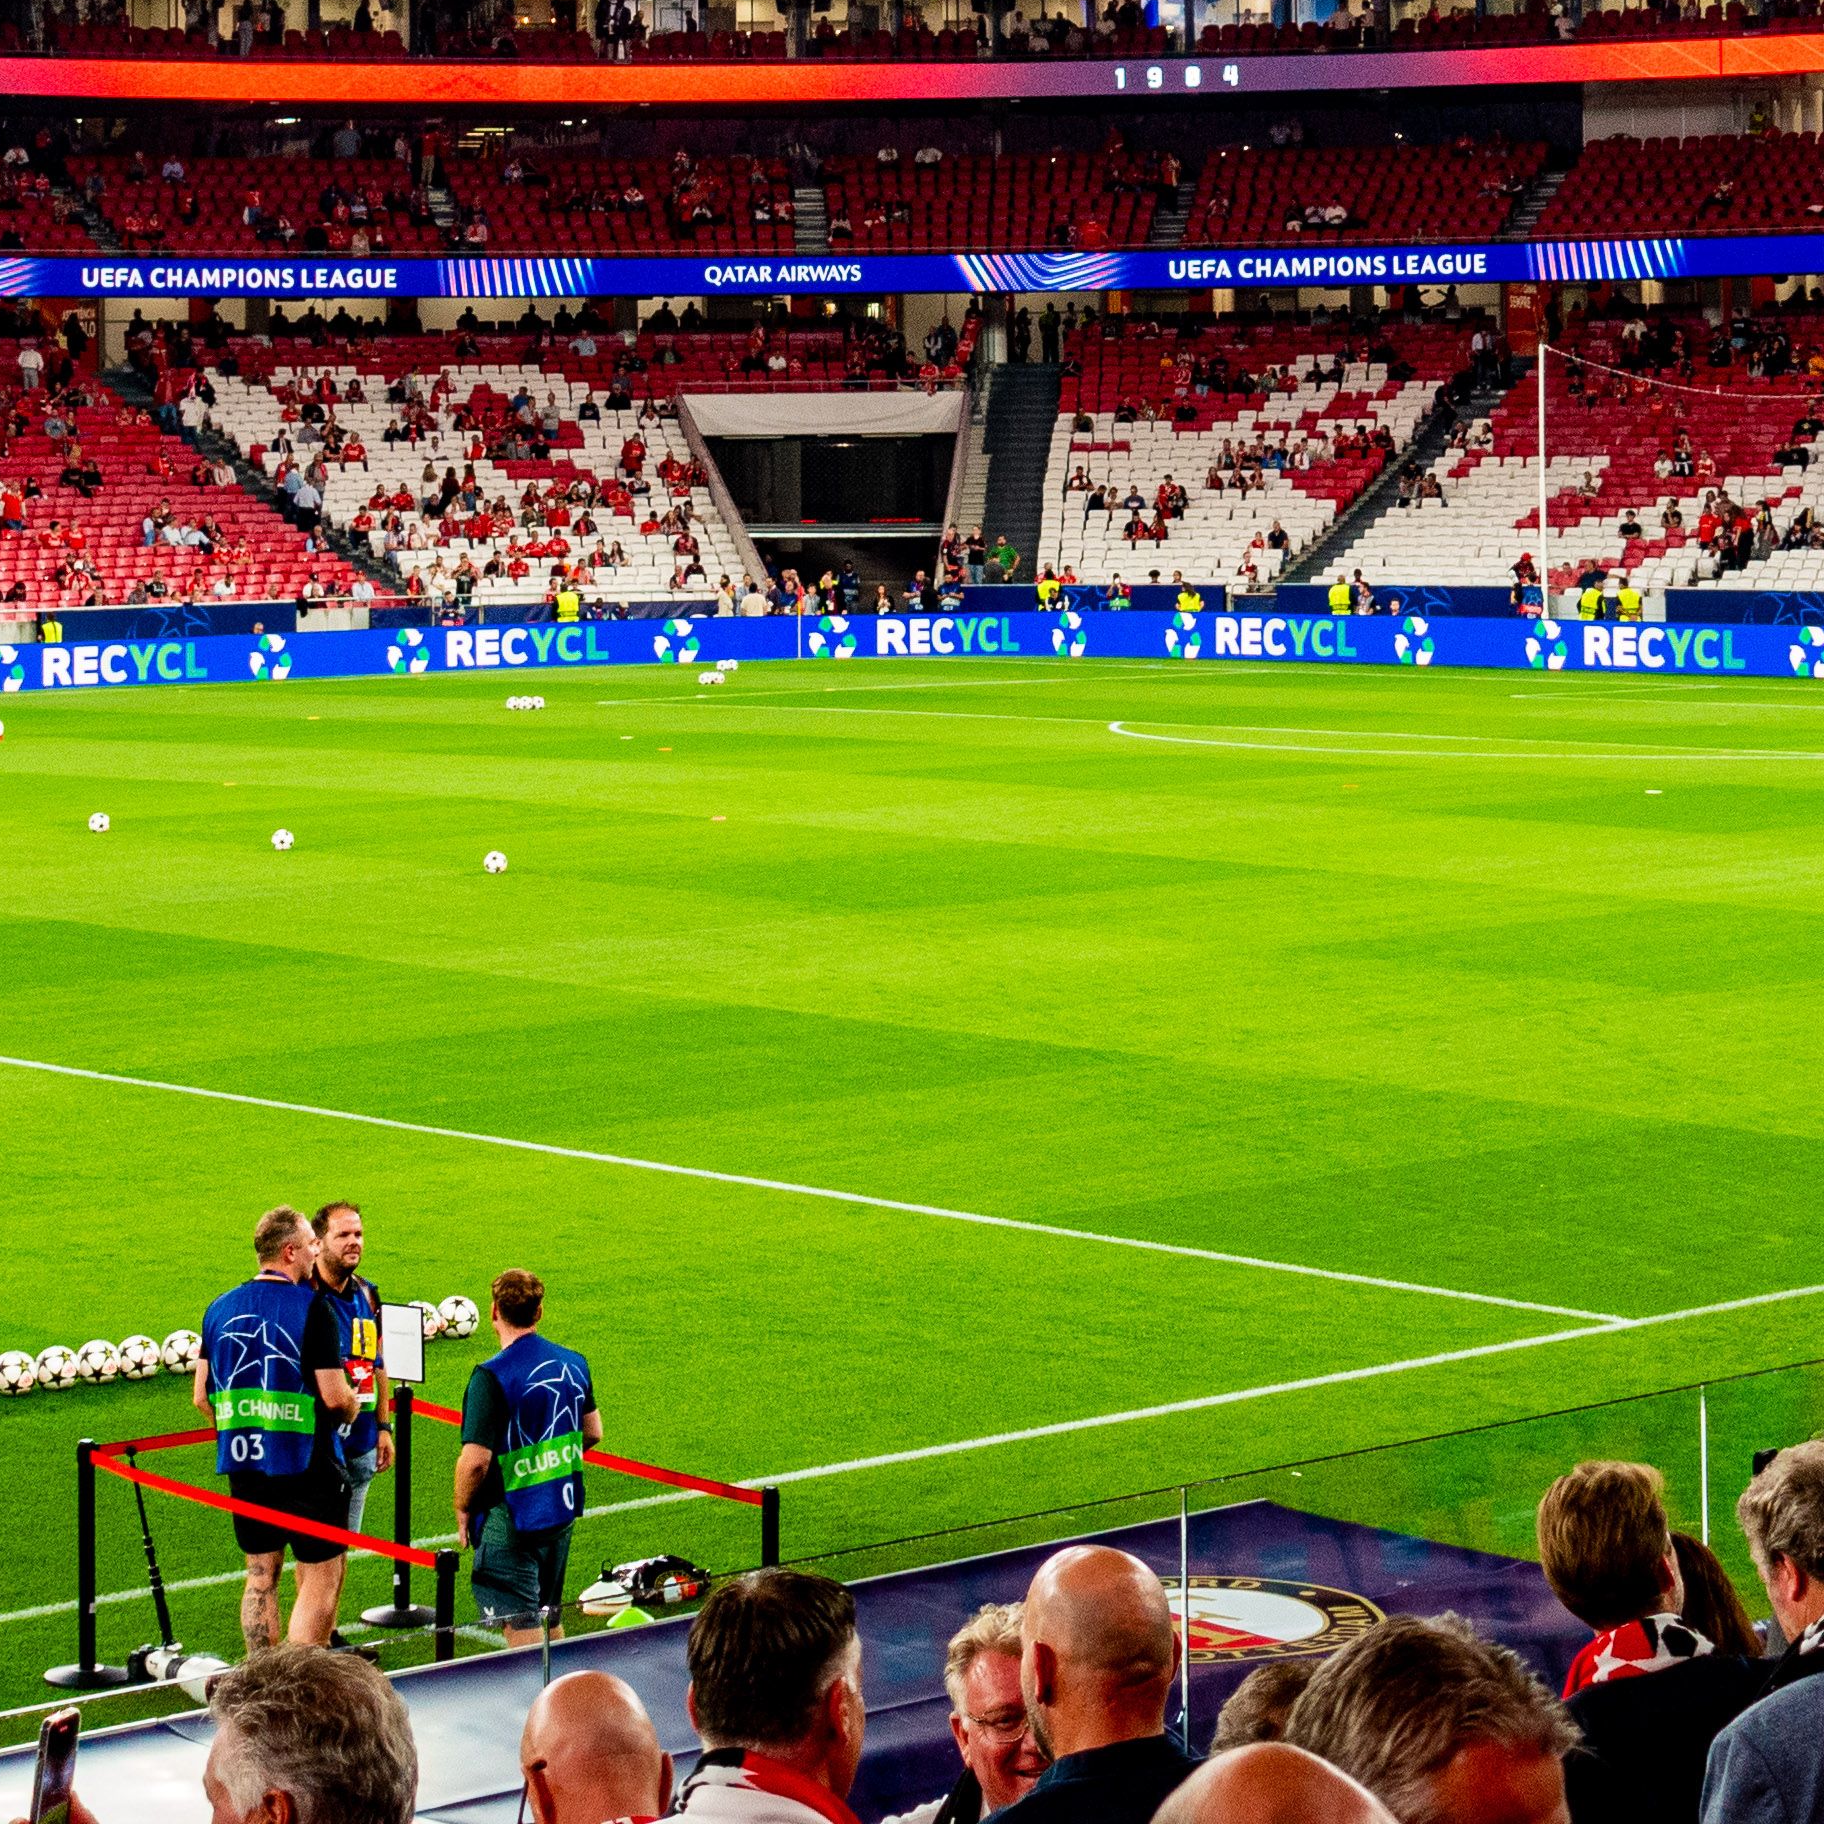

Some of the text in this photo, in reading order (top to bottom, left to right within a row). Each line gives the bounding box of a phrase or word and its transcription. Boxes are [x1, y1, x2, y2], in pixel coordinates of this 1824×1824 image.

[1114, 64, 1239, 90] 1904
[82, 267, 397, 289] UEFA CHAMPIONS LEAGUE
[704, 264, 862, 287] QATAR AIRWAYS
[1169, 253, 1487, 280] UEFA CHAMPIONS LEAGUE
[445, 626, 609, 669] RECYCL
[876, 616, 1020, 656] RECYCL
[1215, 616, 1358, 658] RECYCL
[1582, 624, 1746, 670] RECYCL
[41, 641, 207, 687] RECYCL
[230, 1433, 265, 1462] 03
[513, 1449, 561, 1478] CLUB
